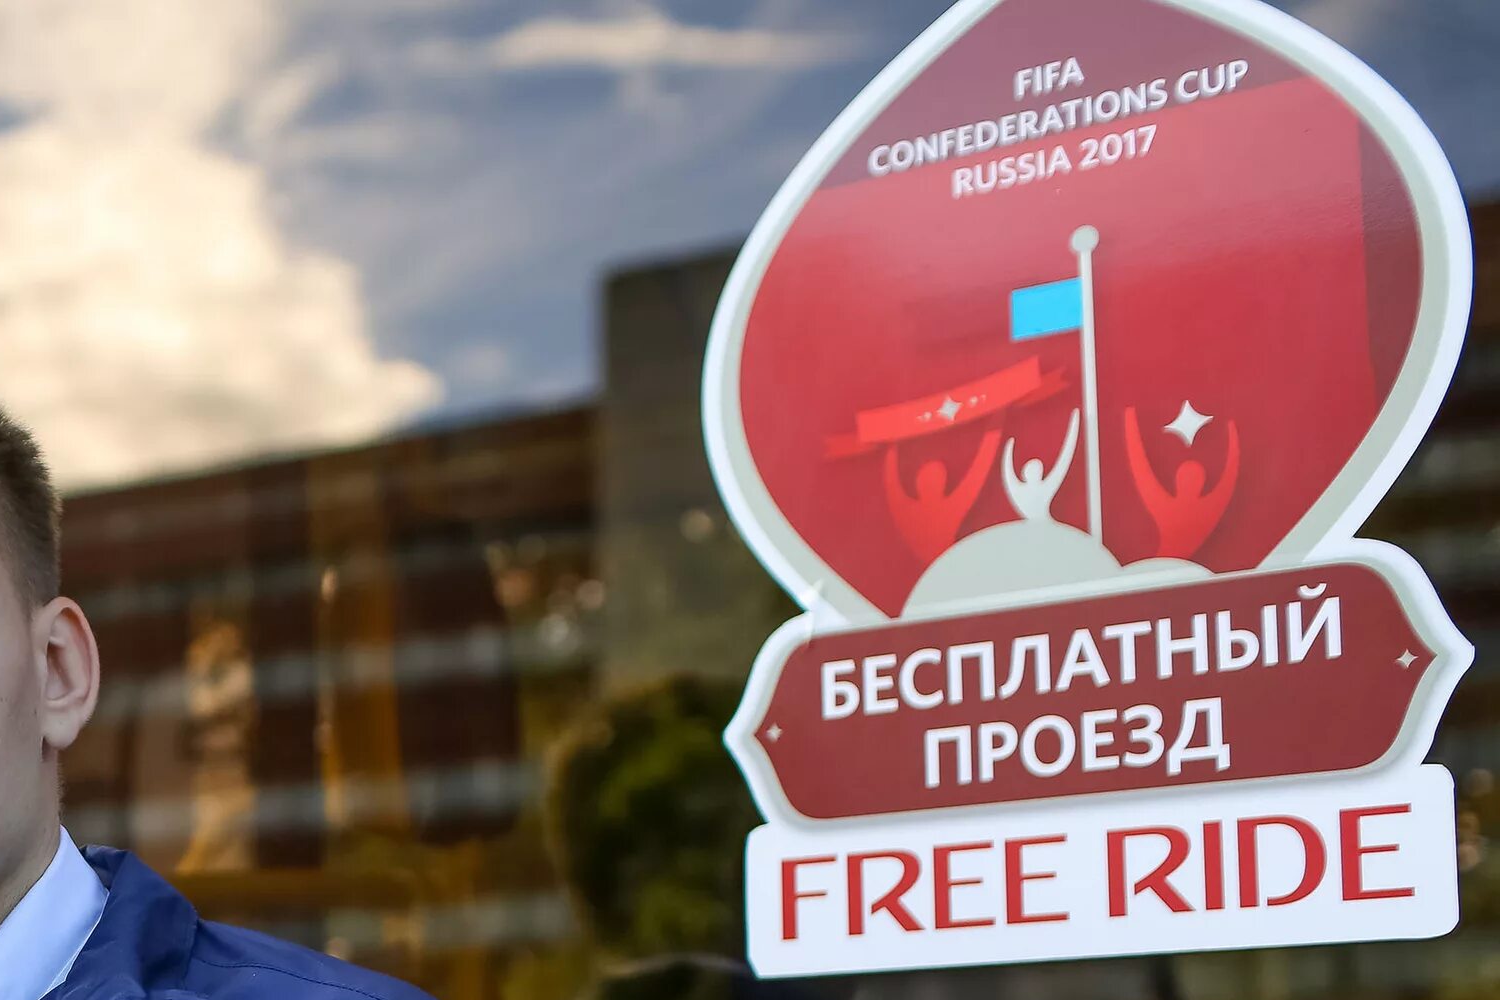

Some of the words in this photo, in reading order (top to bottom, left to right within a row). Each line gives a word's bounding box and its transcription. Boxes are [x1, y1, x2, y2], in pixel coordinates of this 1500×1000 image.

[867, 78, 1168, 177] CONFEDERATIONS
[1174, 59, 1248, 104] CUP
[1013, 56, 1084, 100] FIFA
[952, 145, 1071, 199] RUSSIA
[1079, 124, 1157, 171] 2017
[820, 583, 1343, 720] БЕСПЛАТНЫЙ
[924, 697, 1231, 788] ПРОЕЗД
[780, 834, 1071, 941] FREE
[1106, 803, 1415, 918] RIDE
